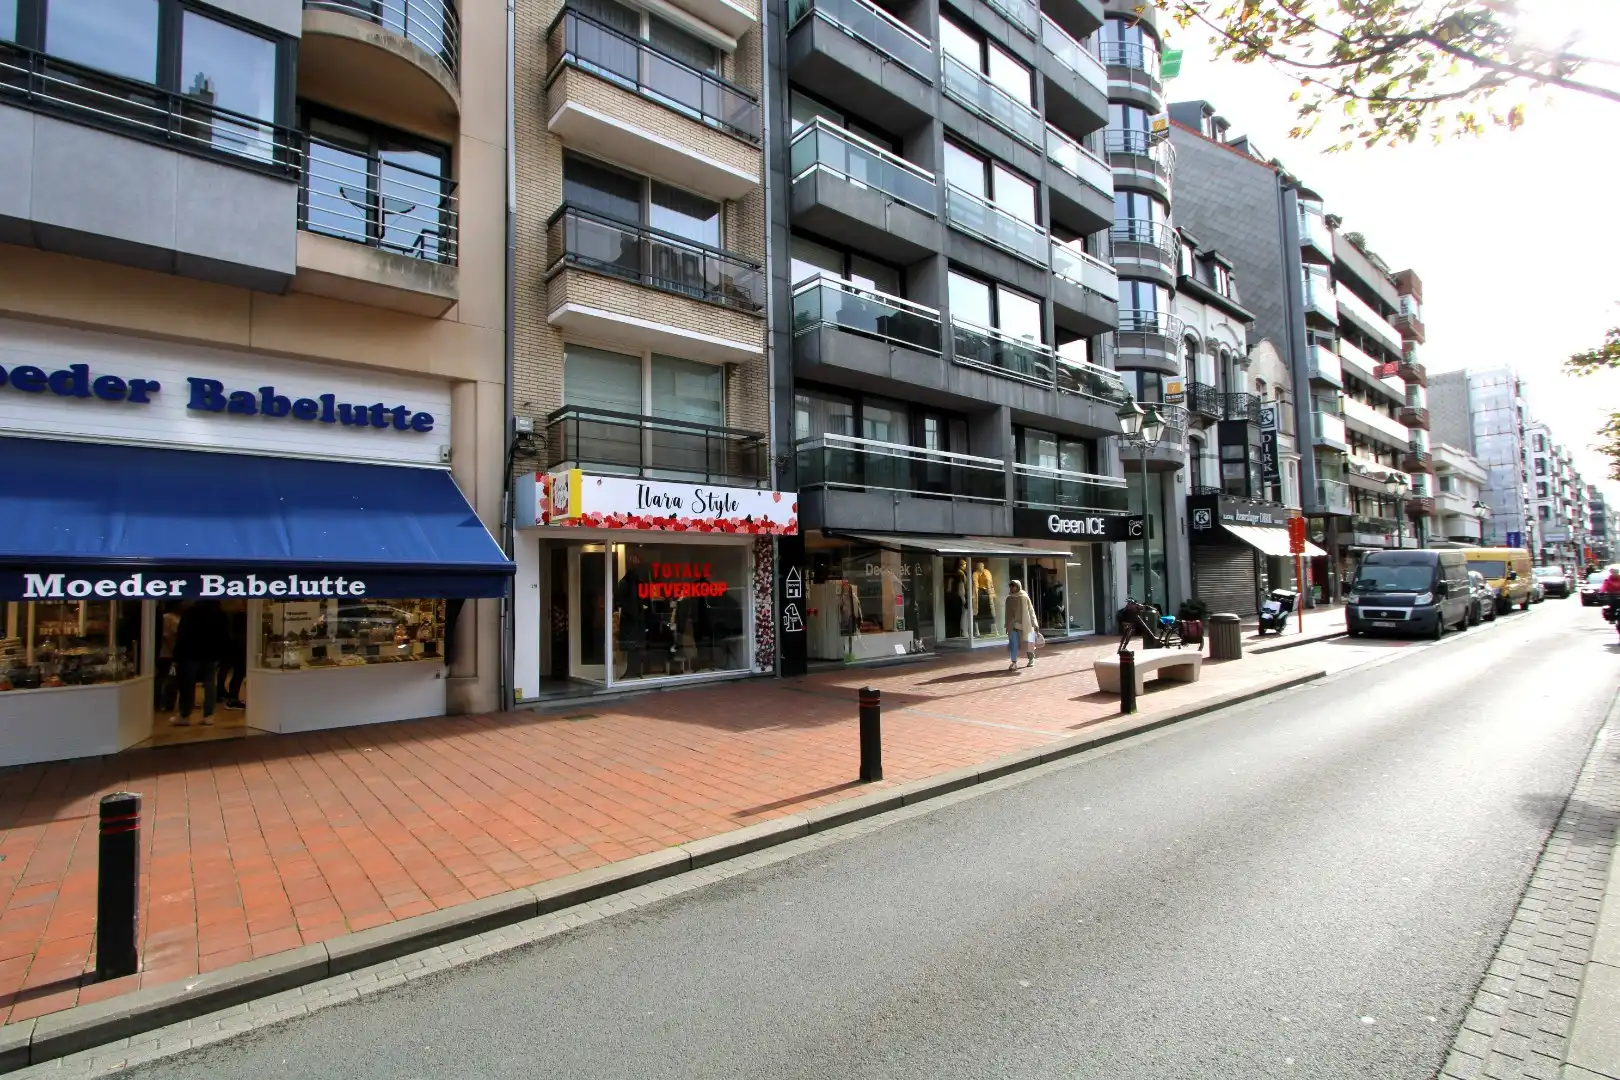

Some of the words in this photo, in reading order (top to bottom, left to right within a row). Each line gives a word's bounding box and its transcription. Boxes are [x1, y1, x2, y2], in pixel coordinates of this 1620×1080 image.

[0, 363, 161, 403] eder
[186, 377, 435, 432] Babelutte
[1262, 434, 1273, 472] DIRK
[636, 484, 683, 509] Ilara
[691, 489, 739, 519] Style
[1048, 514, 1085, 534] Green
[1085, 517, 1105, 535] ICE
[652, 562, 712, 578] TOTALE
[23, 573, 187, 598] Moeder
[200, 574, 366, 597] Babelutte
[638, 581, 729, 599] UITVERKOOP
